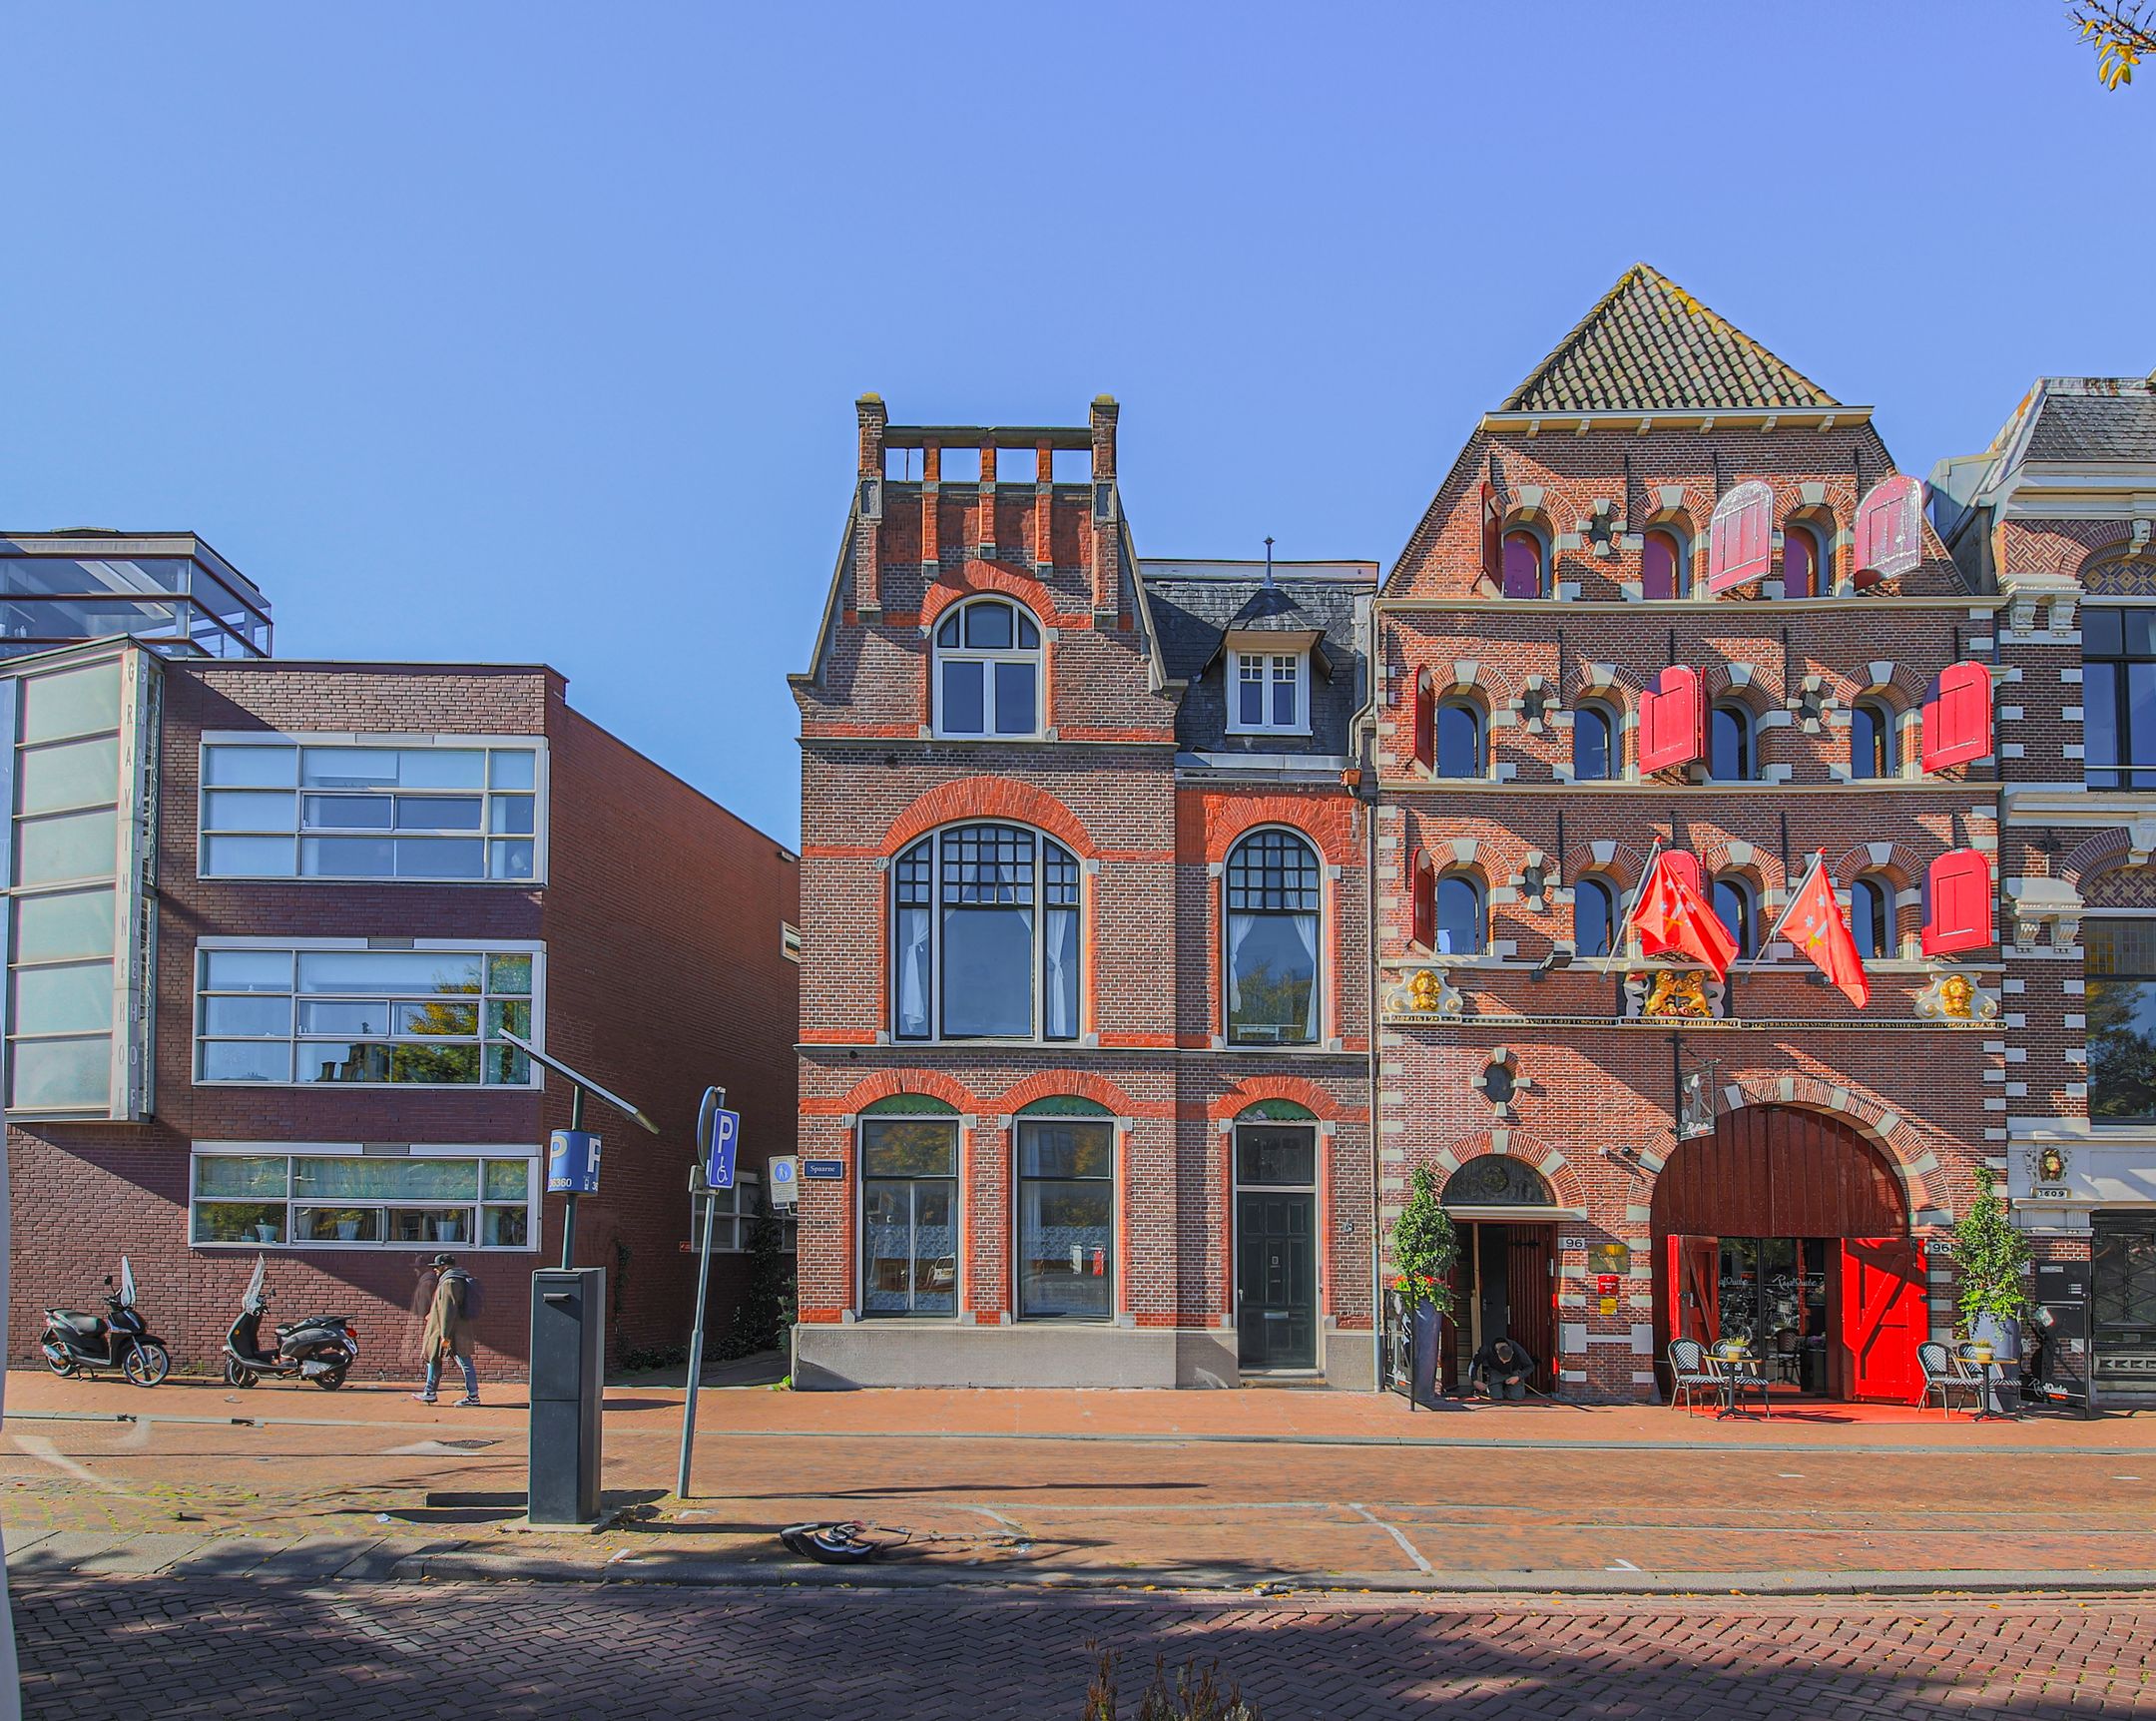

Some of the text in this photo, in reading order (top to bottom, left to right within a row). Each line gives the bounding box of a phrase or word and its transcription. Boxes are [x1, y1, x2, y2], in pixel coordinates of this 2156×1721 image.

[719, 1115, 734, 1153] P
[549, 1135, 568, 1172] P
[809, 1165, 836, 1174] Spaarne
[1566, 1239, 1583, 1248] 96
